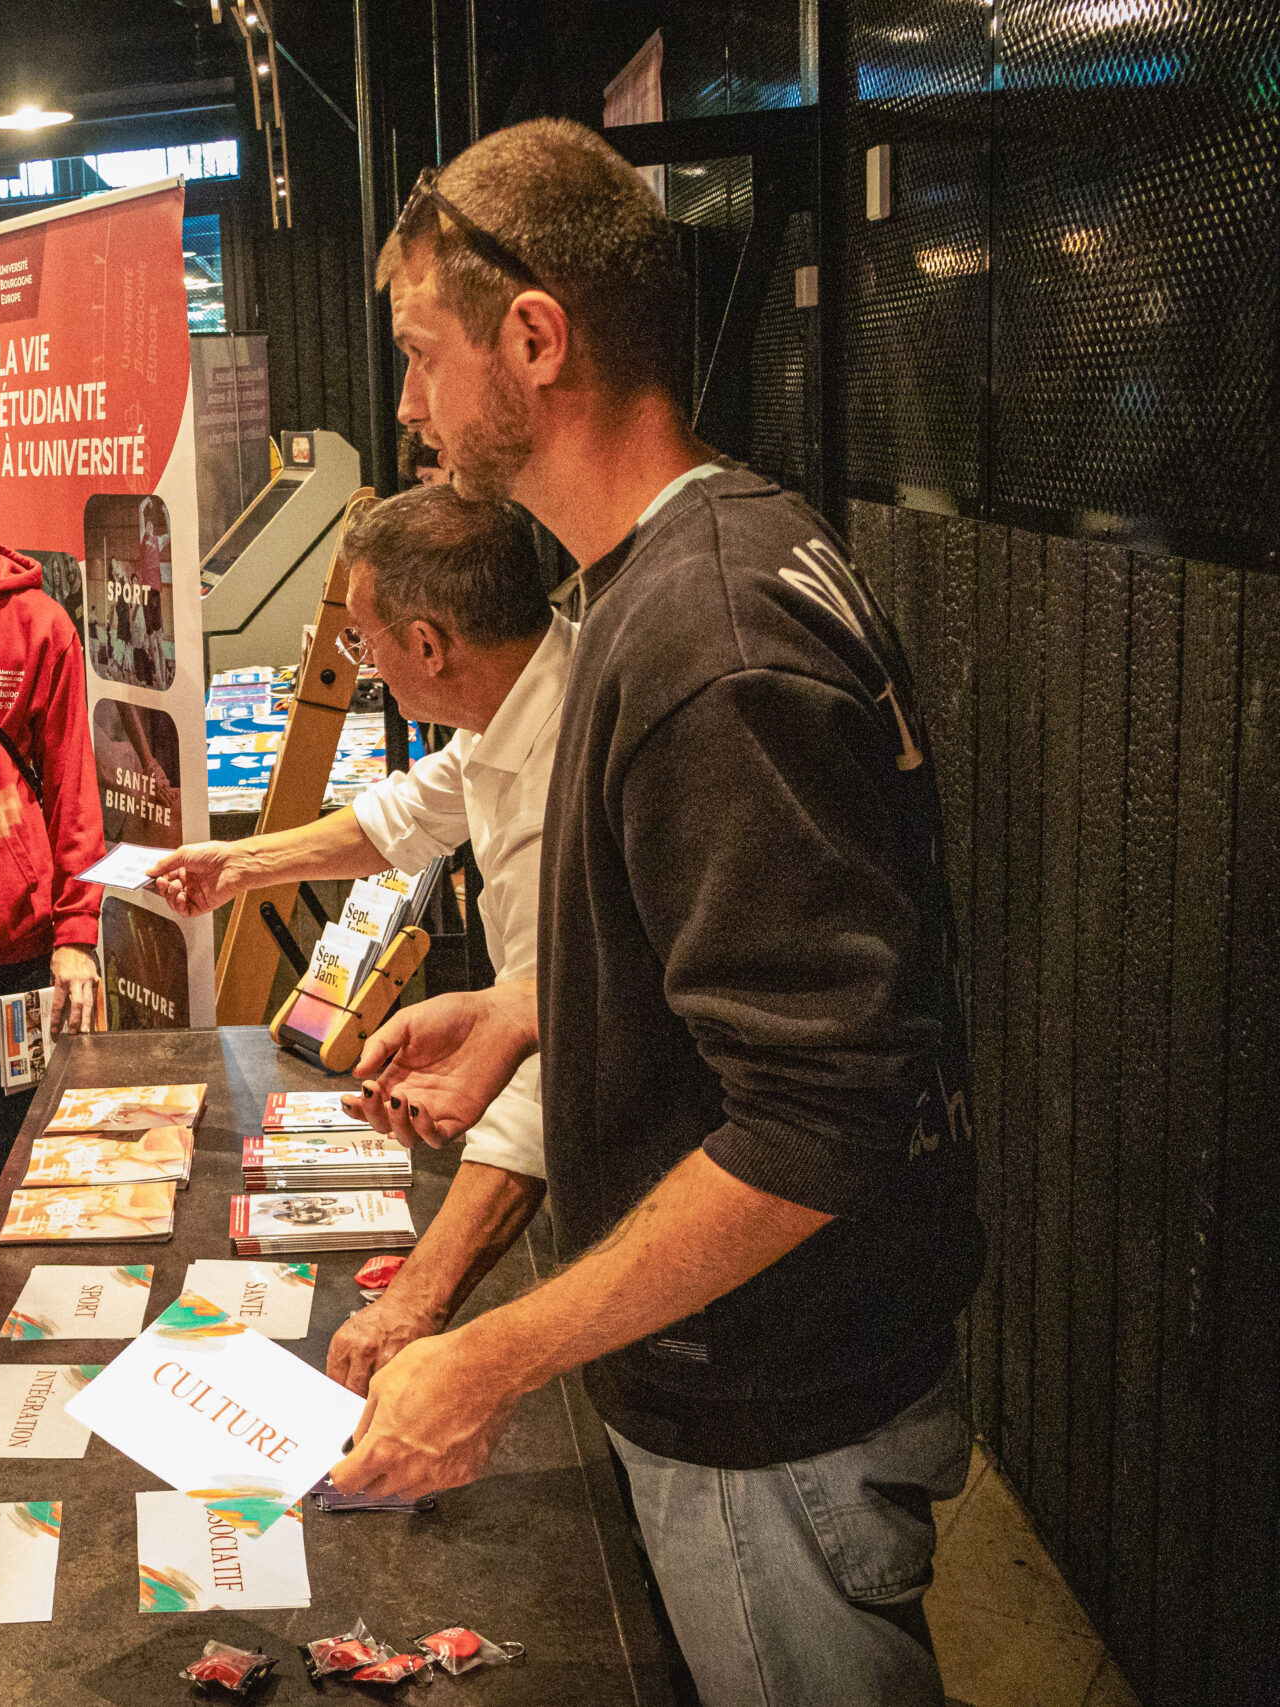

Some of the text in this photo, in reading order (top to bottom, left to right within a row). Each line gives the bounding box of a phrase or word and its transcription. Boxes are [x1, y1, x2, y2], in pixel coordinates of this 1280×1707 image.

[0, 274, 32, 290] BOURGOGNE
[1, 292, 22, 305] EUROPE
[21, 333, 50, 374] VIE
[0, 381, 106, 427] ÉTUDIANTE
[1, 424, 145, 477] À L'UNIVERSITÉ
[107, 580, 152, 606] SPORT
[116, 767, 156, 796] SANTÉ
[105, 789, 171, 827] BIEN-ÊTRE
[345, 902, 370, 925] Sept.
[316, 945, 340, 969] Sept.
[312, 963, 339, 988] -Janv.
[118, 977, 175, 1020] CULTURE
[75, 1284, 104, 1319] SPORT
[239, 1281, 269, 1317] SANTÉ
[7, 1369, 58, 1449] INTÉGRATION
[152, 1361, 299, 1464] CULTURE
